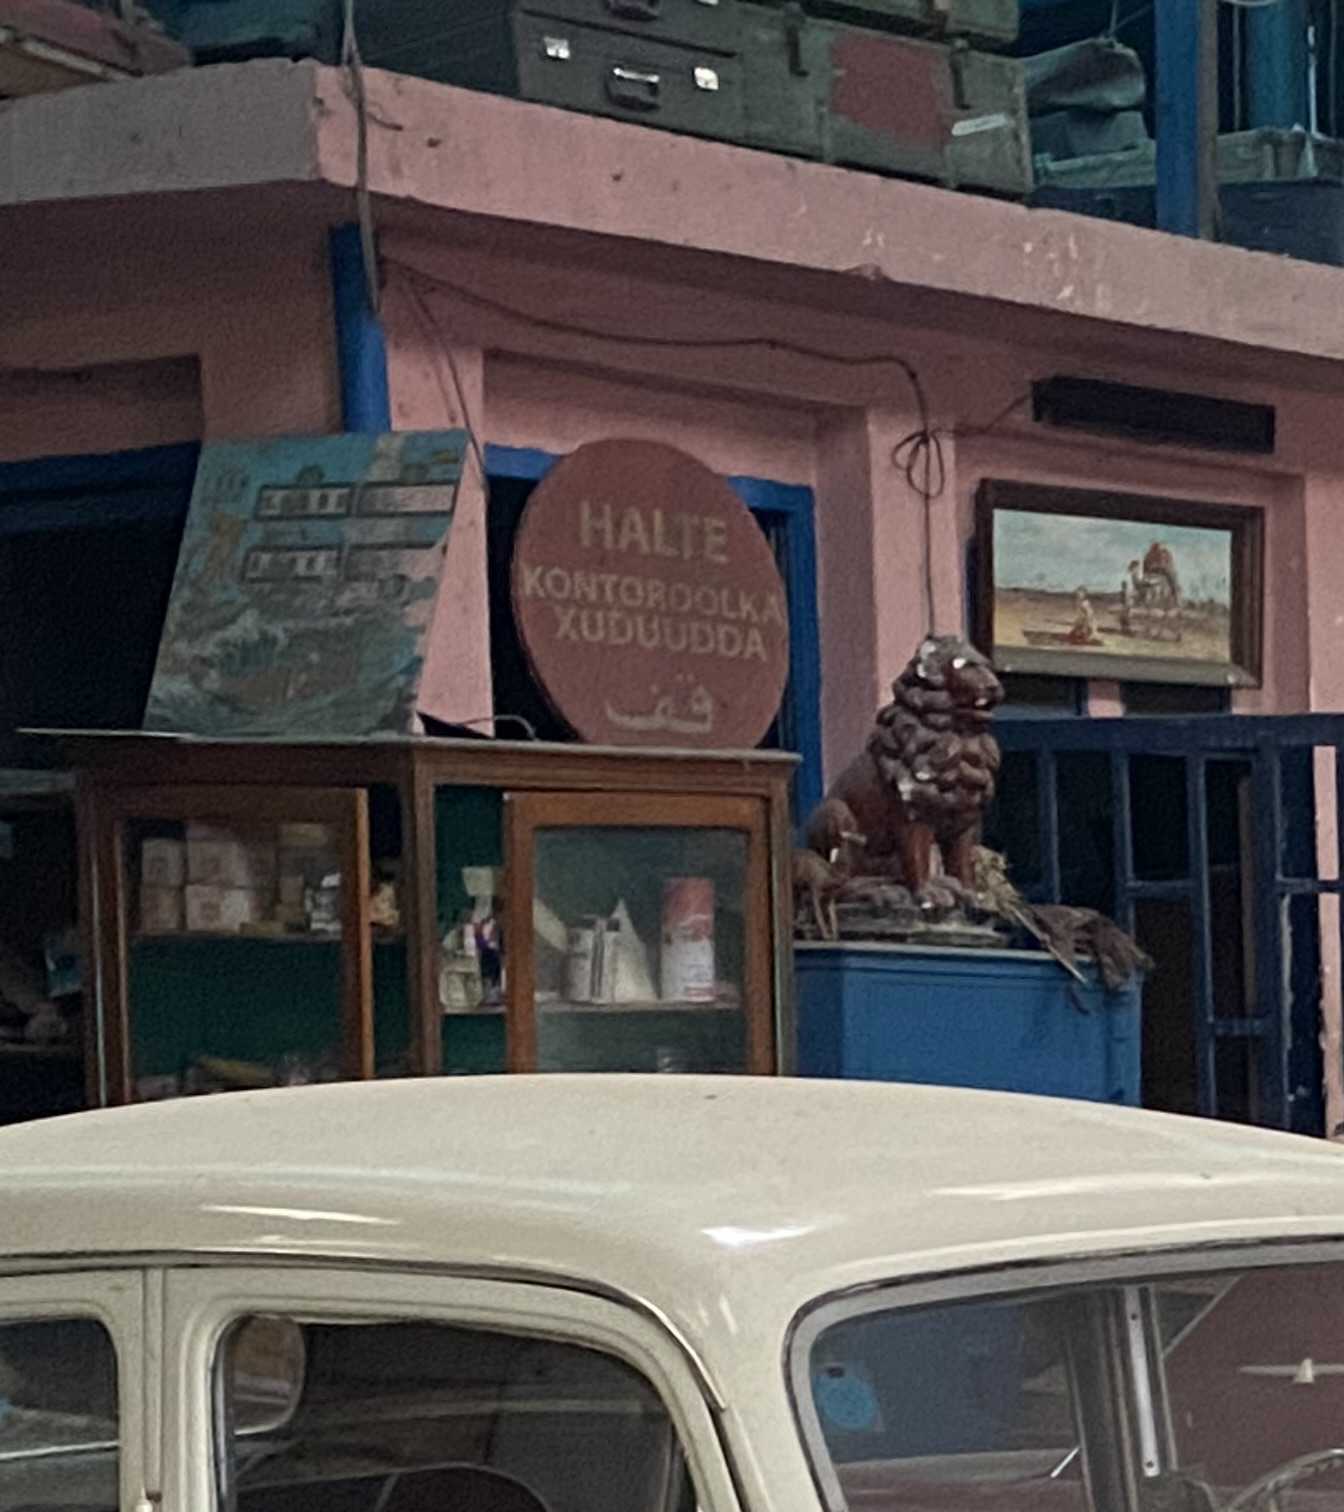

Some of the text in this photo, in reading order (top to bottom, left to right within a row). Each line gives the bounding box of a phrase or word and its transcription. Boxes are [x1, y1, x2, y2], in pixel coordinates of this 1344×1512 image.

[579, 501, 729, 564] HALTE
[521, 565, 784, 627] KONTOROOLKA
[604, 674, 714, 735] قف
